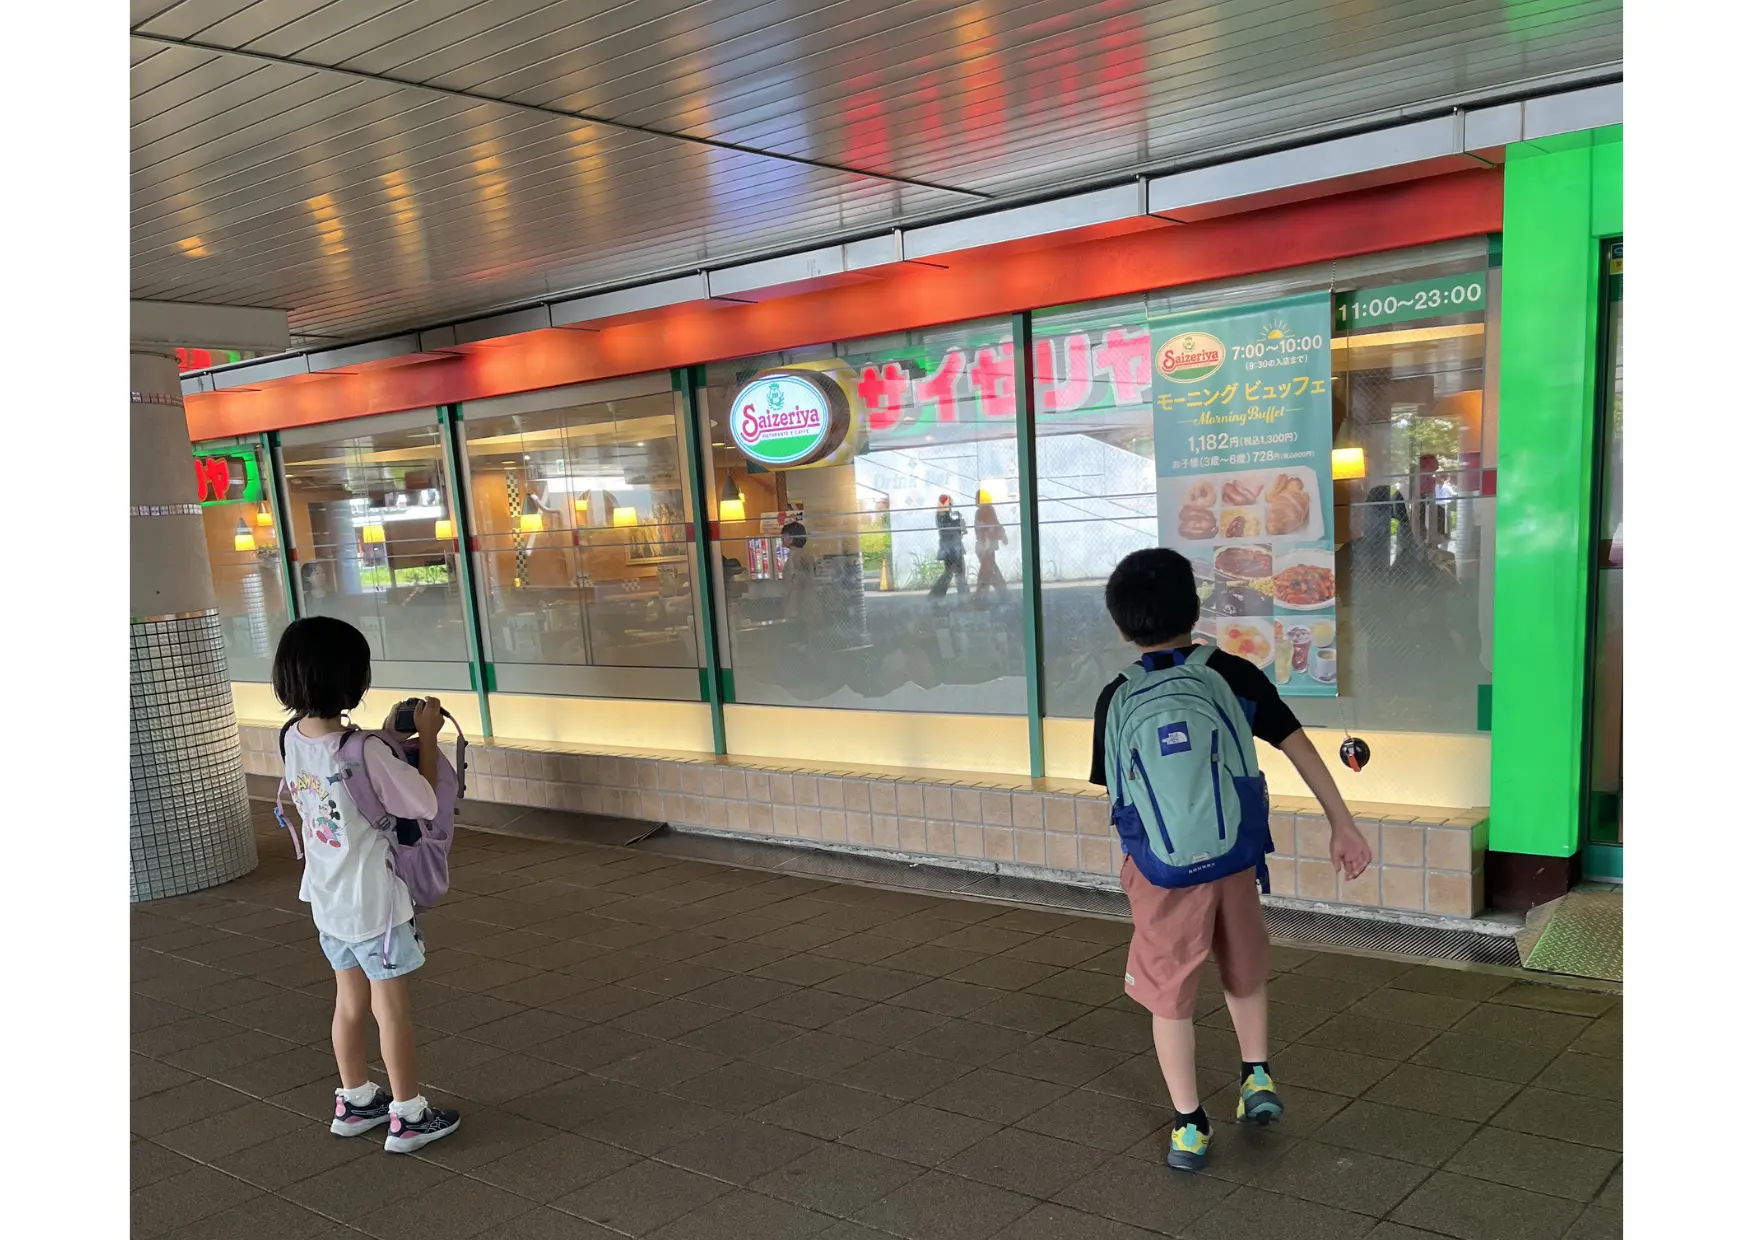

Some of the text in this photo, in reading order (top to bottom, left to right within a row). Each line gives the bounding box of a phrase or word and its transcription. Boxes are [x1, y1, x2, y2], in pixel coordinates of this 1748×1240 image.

[1162, 350, 1220, 374] Saizeriya
[858, 330, 1152, 431] サイゼリヤ
[1157, 376, 1326, 411] モーニング ビュッフェ
[741, 403, 820, 441] Saizeriya
[1193, 406, 1285, 426] Morning Buffet
